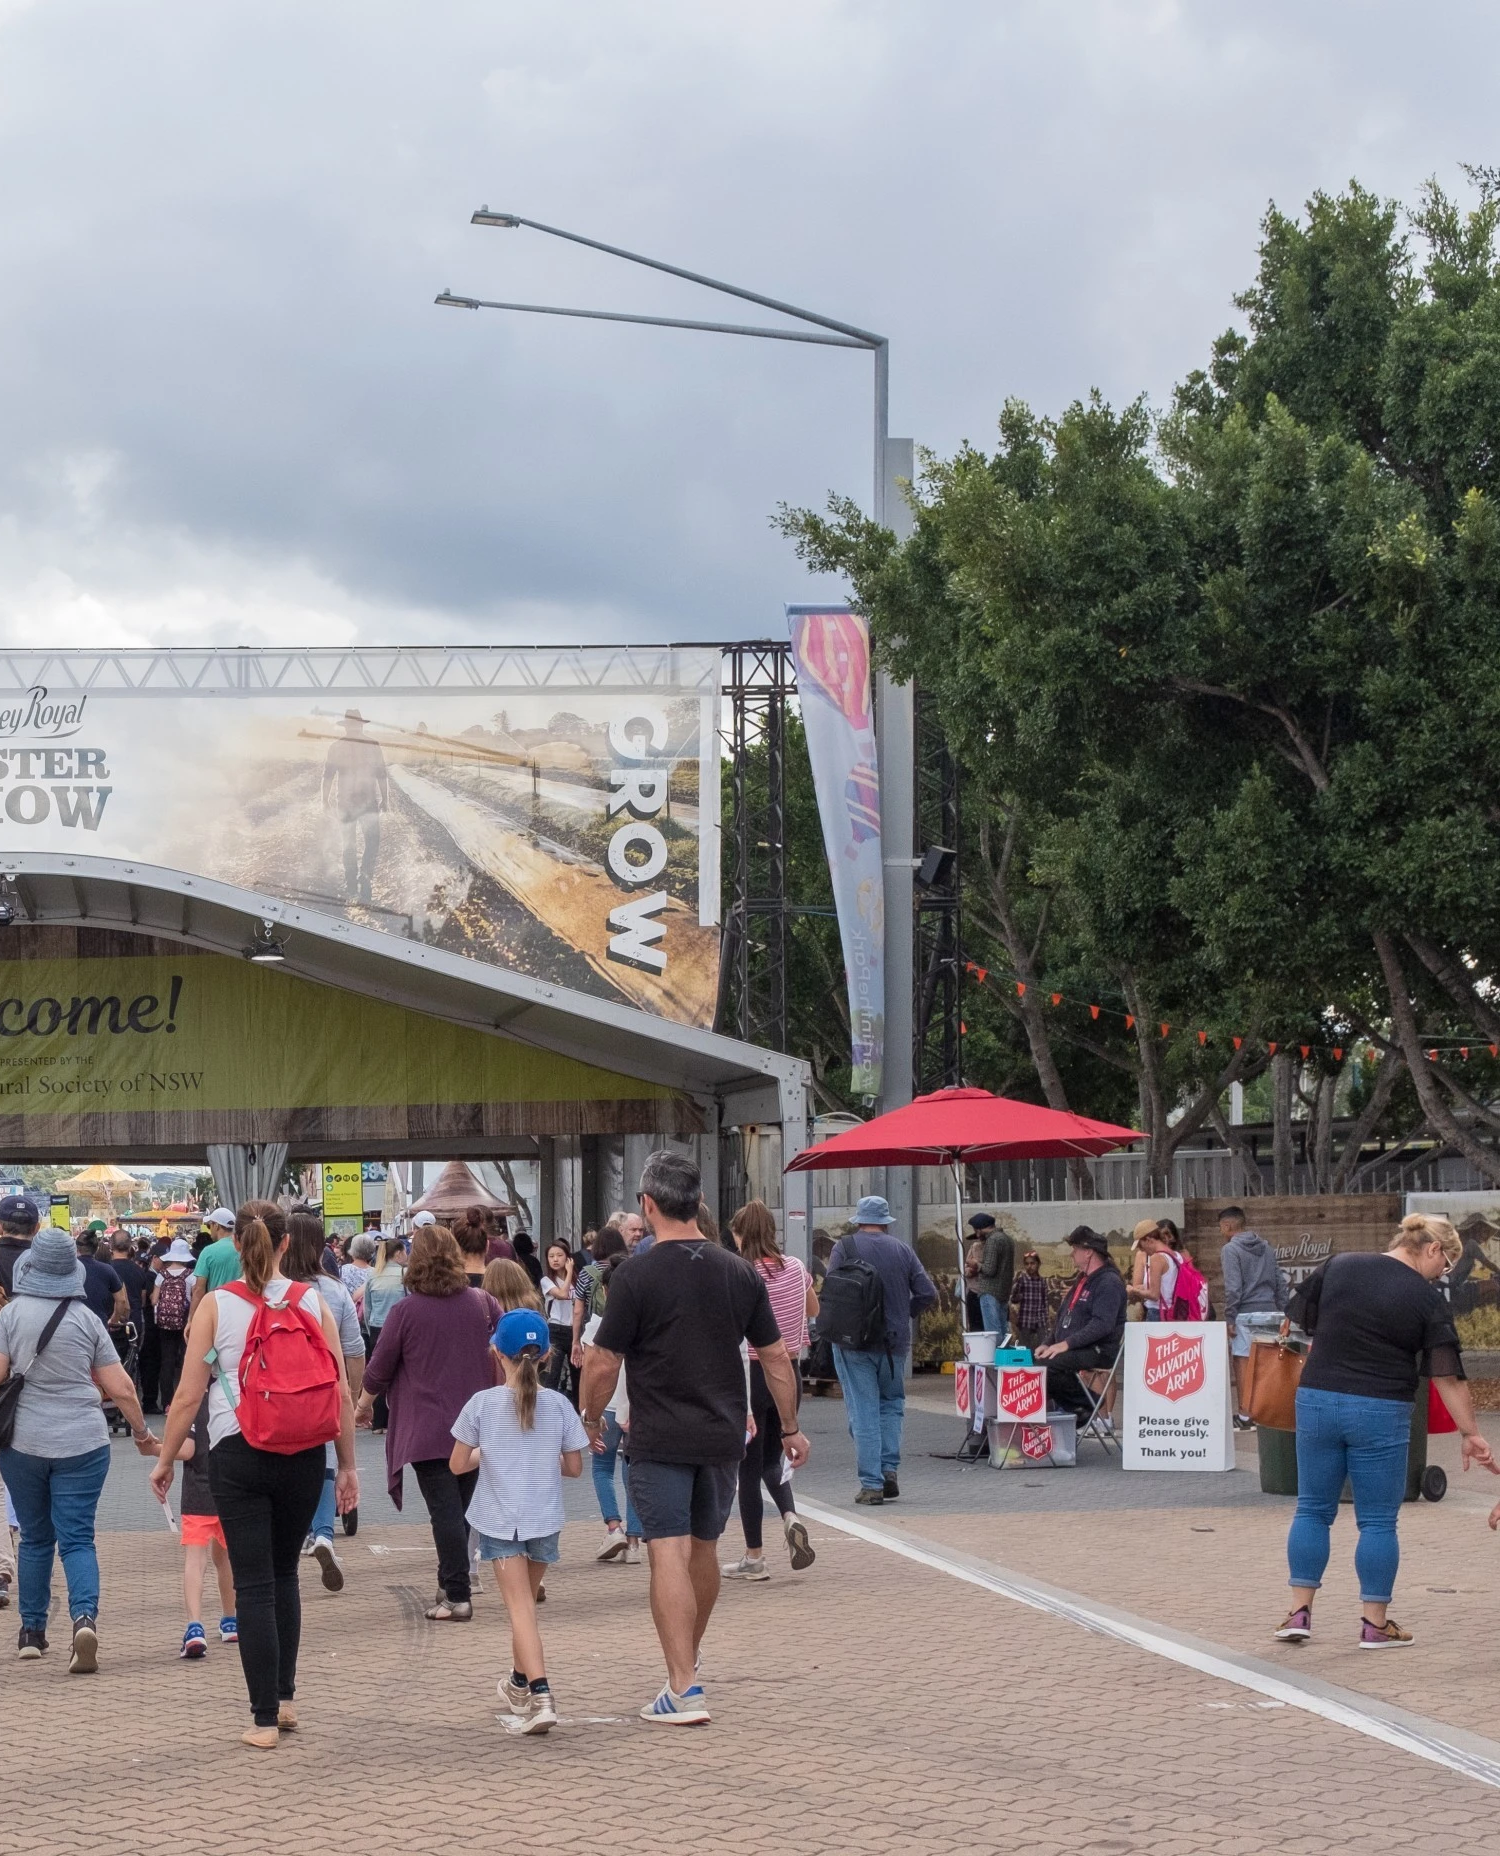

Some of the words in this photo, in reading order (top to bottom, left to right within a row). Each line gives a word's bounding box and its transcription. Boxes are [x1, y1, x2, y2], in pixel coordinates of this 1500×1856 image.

[22, 686, 88, 733] Royal
[606, 708, 669, 976] GROW
[0, 1057, 57, 1067] PRESENTED
[60, 1056, 73, 1066] BY
[75, 1055, 94, 1065] THE
[38, 1075, 113, 1098] Society
[120, 1073, 145, 1093] of
[148, 1071, 204, 1092] NSW
[1297, 1233, 1332, 1259] Royal
[1155, 1338, 1181, 1361] THE
[1146, 1341, 1201, 1385] SALVATION
[1008, 1373, 1025, 1389] THE
[1165, 1362, 1199, 1395] ARMY
[1002, 1376, 1040, 1407] SALVATION
[1015, 1390, 1038, 1414] ARMY
[1138, 1416, 1180, 1426] Please
[1184, 1417, 1210, 1428] give
[1138, 1427, 1210, 1439] generously.
[1141, 1447, 1177, 1458] Thank
[1180, 1448, 1207, 1459] you!
